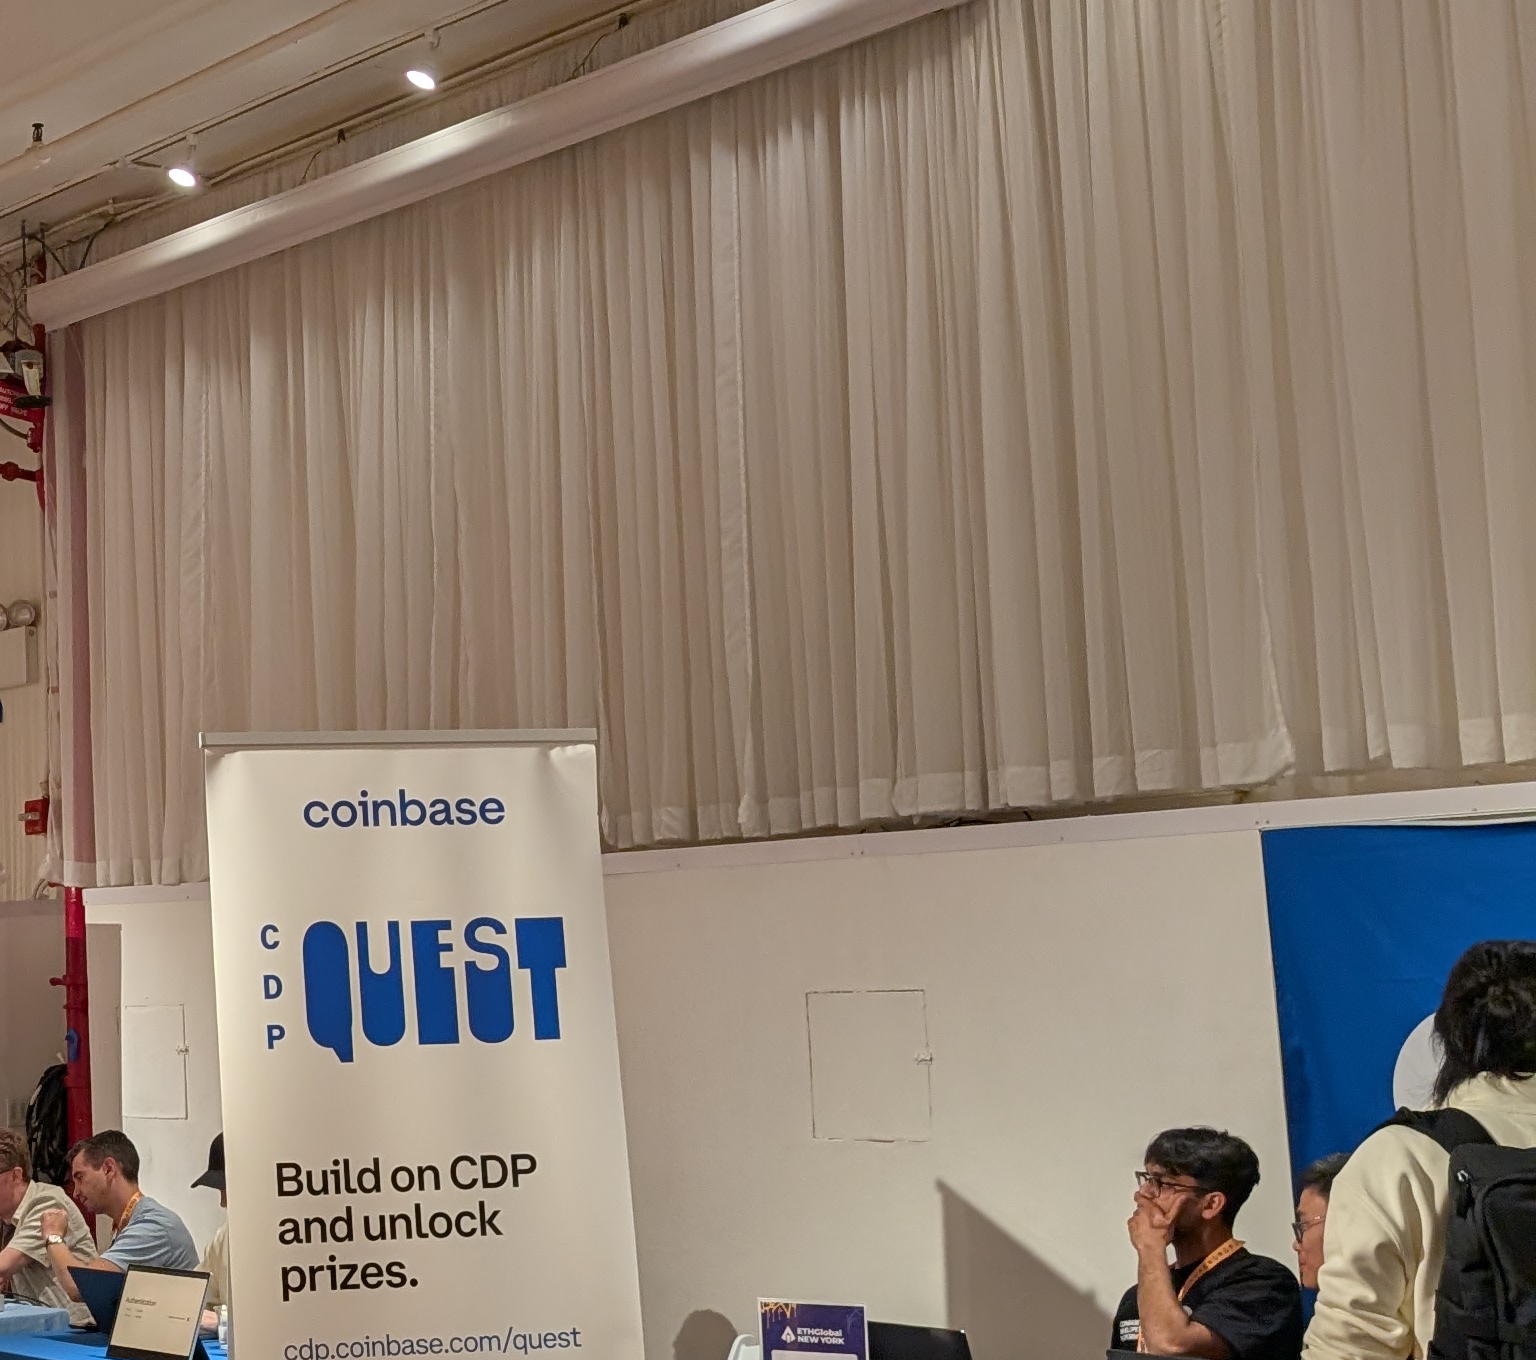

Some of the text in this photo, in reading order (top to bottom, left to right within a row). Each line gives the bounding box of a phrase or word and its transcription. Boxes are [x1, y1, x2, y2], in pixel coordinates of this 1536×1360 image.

[303, 789, 506, 828] coinbase
[302, 916, 568, 1064] QUEST
[275, 1153, 538, 1198] Build on CDP
[277, 1200, 504, 1244] and unlock
[280, 1257, 420, 1302] prizes.
[797, 1327, 843, 1337] ETHGlobal
[797, 1335, 845, 1345] NEW YORK
